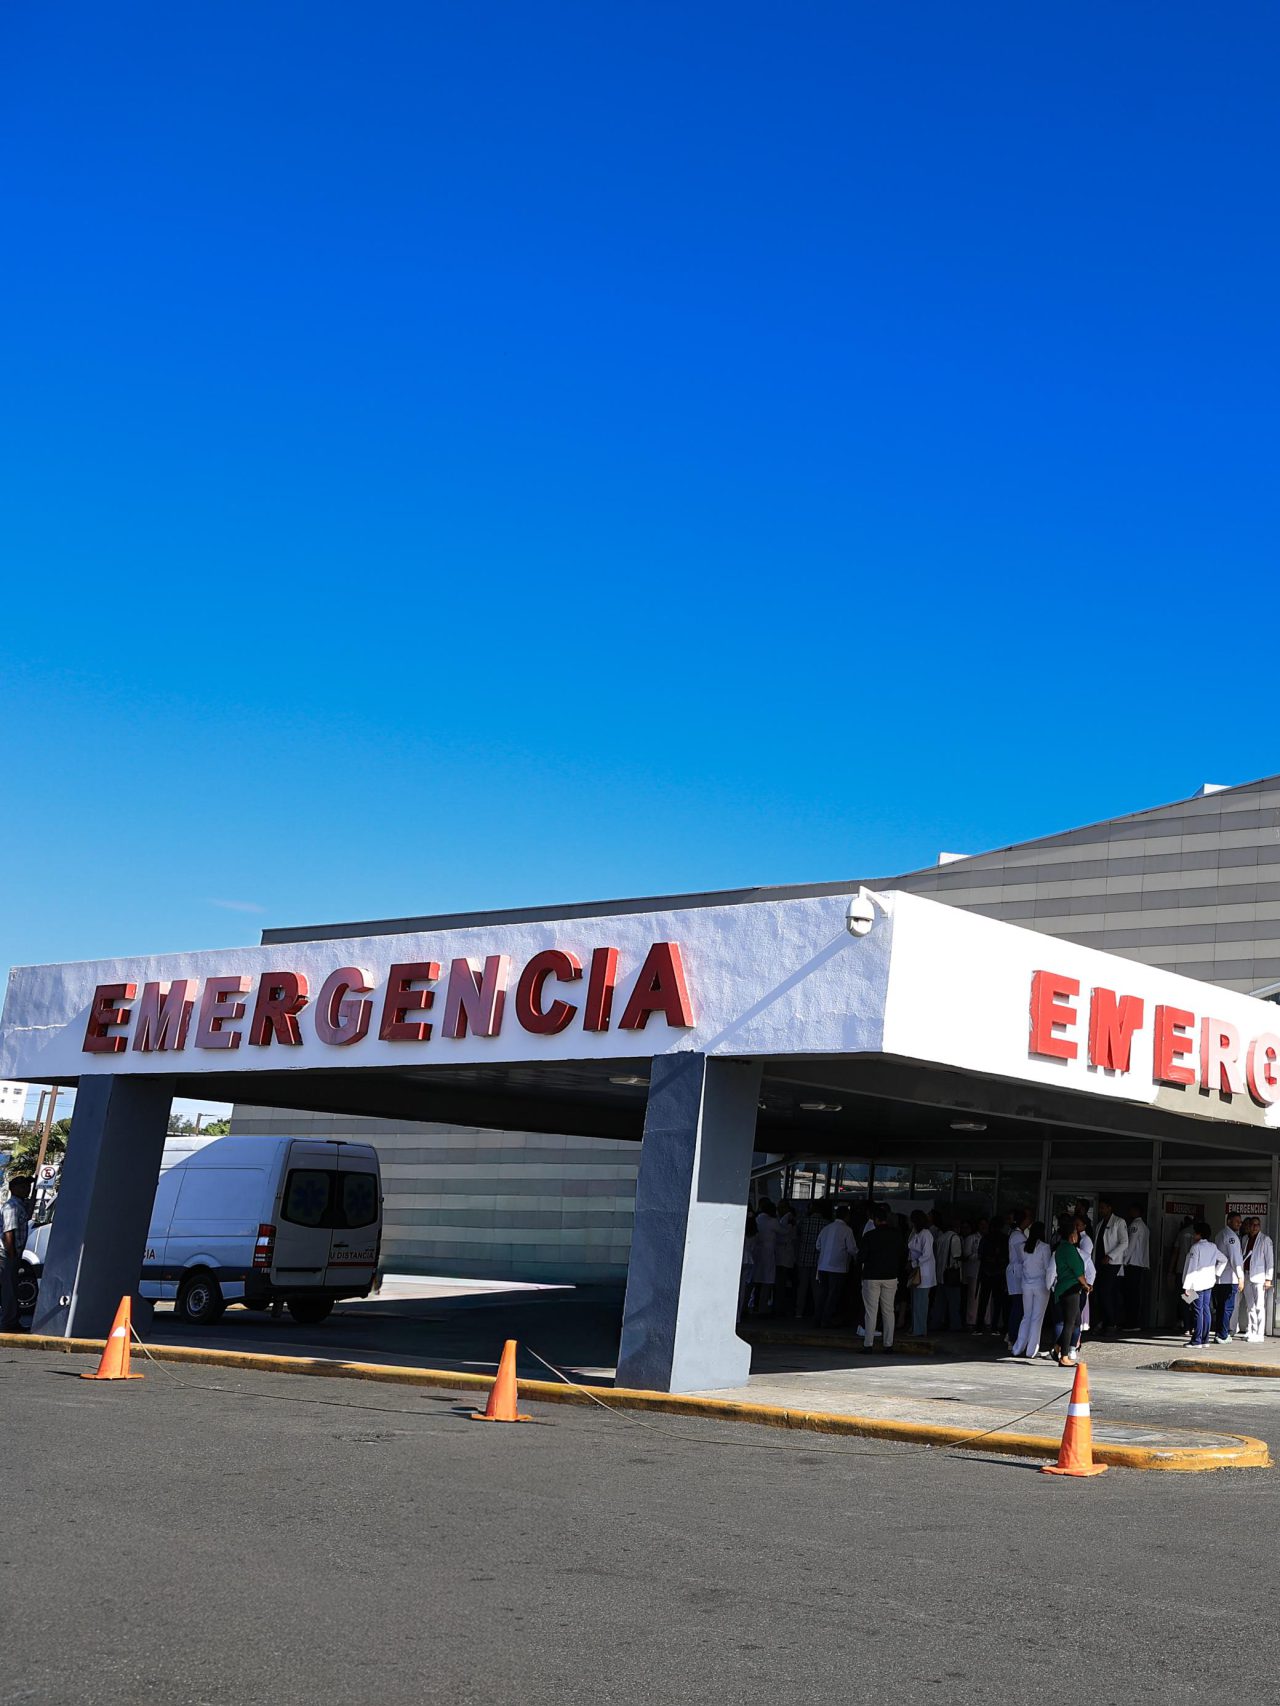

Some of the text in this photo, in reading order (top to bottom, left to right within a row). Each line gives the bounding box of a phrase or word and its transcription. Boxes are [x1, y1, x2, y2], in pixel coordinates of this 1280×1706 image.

[82, 942, 695, 1054] EMERGENCIA
[1228, 1204, 1267, 1214] EMERGENCIAS
[336, 1250, 374, 1259] DISTANCIA
